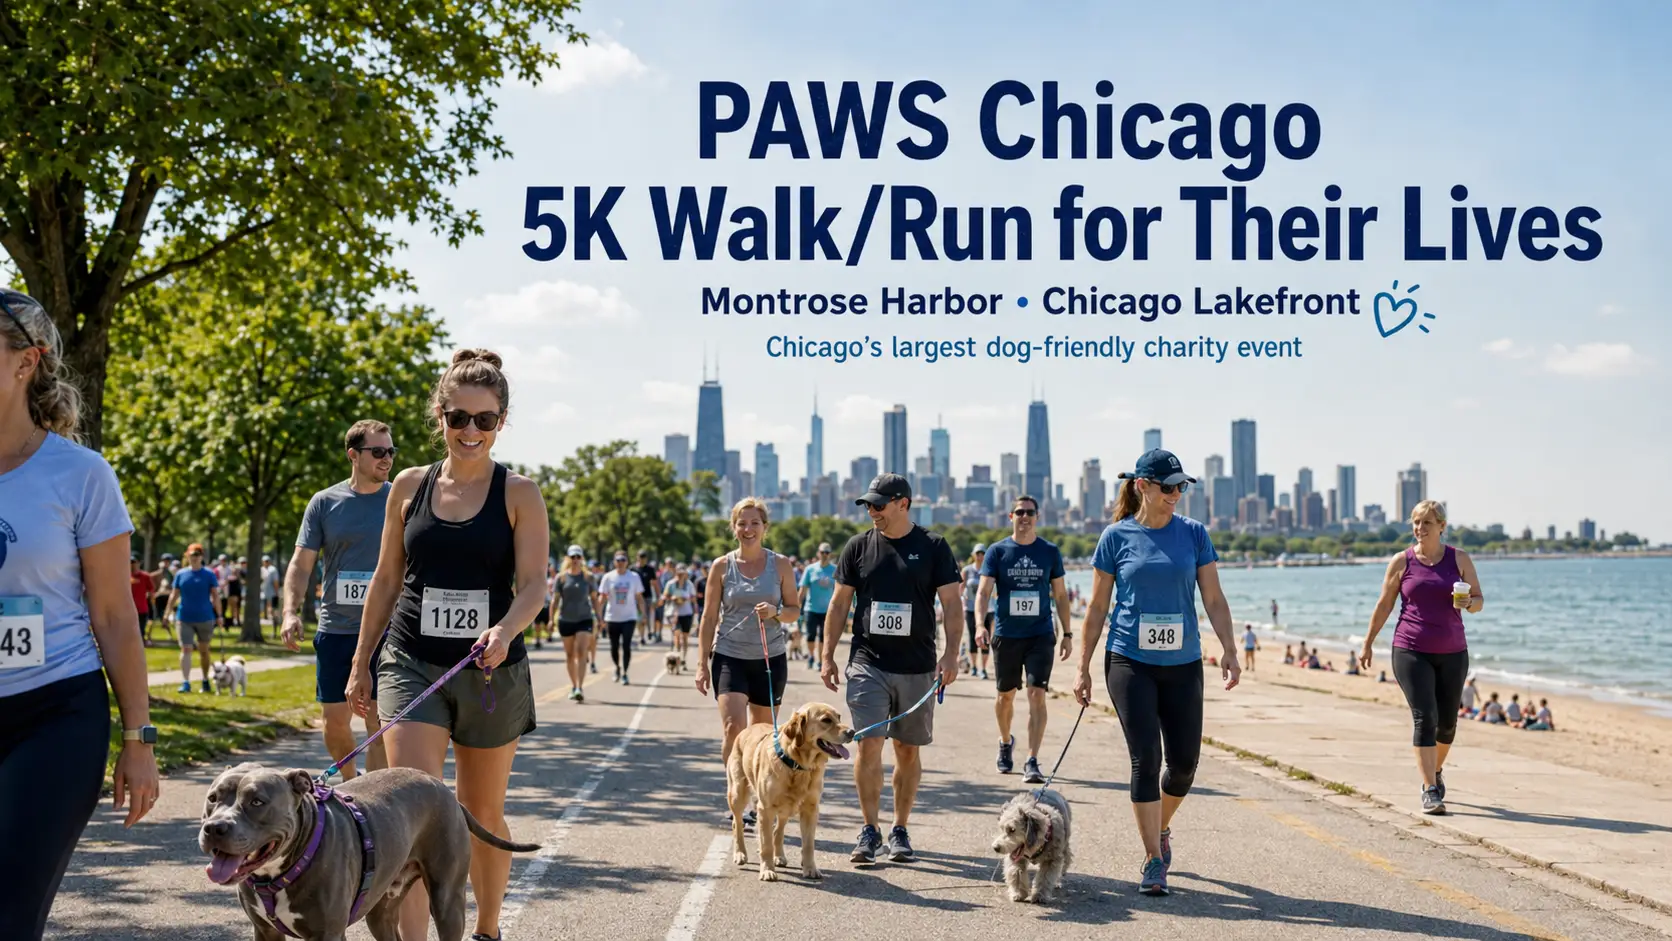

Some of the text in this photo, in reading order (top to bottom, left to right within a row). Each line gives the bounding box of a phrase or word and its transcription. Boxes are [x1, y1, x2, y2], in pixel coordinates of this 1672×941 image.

[343, 583, 367, 599] 187
[1016, 600, 1034, 611] 197
[431, 607, 478, 629] 1128
[877, 614, 903, 630] 308
[1148, 628, 1175, 645] 348
